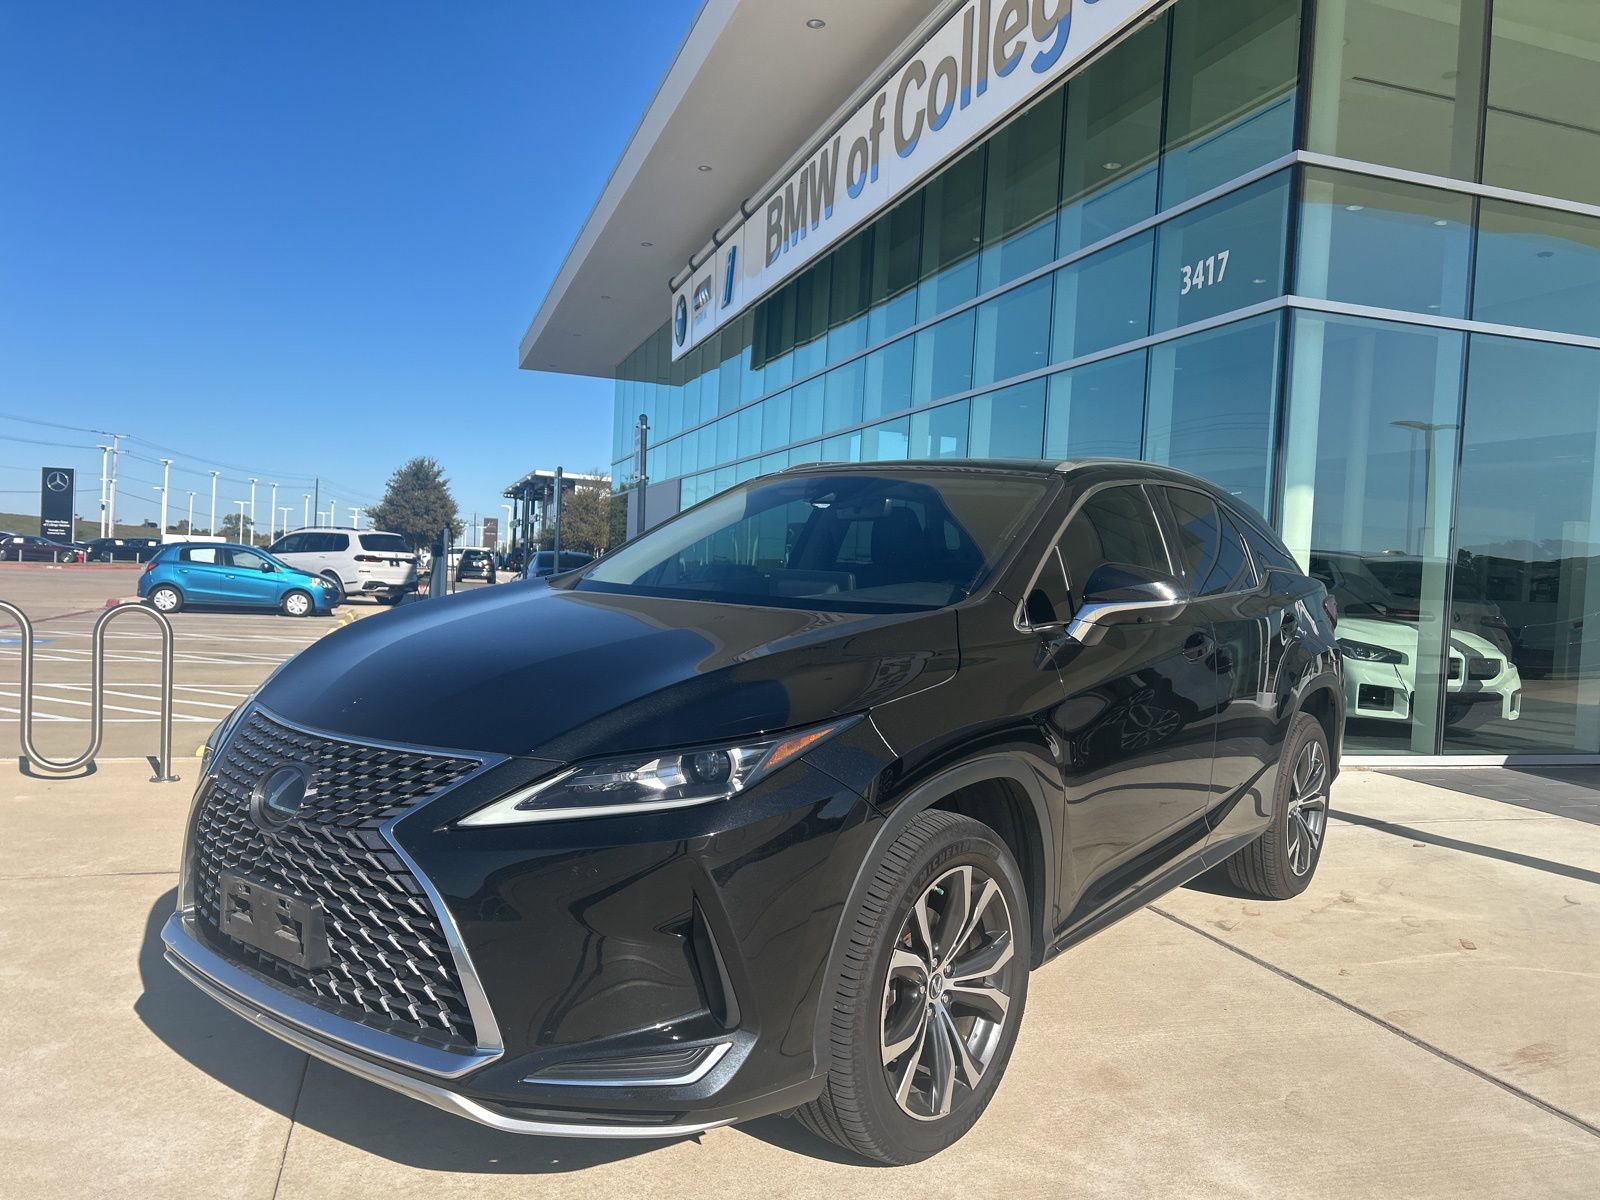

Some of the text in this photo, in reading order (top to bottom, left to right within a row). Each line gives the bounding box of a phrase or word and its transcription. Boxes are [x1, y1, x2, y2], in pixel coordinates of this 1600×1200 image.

[765, 0, 1099, 269] BMW of Colleg
[1180, 249, 1230, 296] 3417
